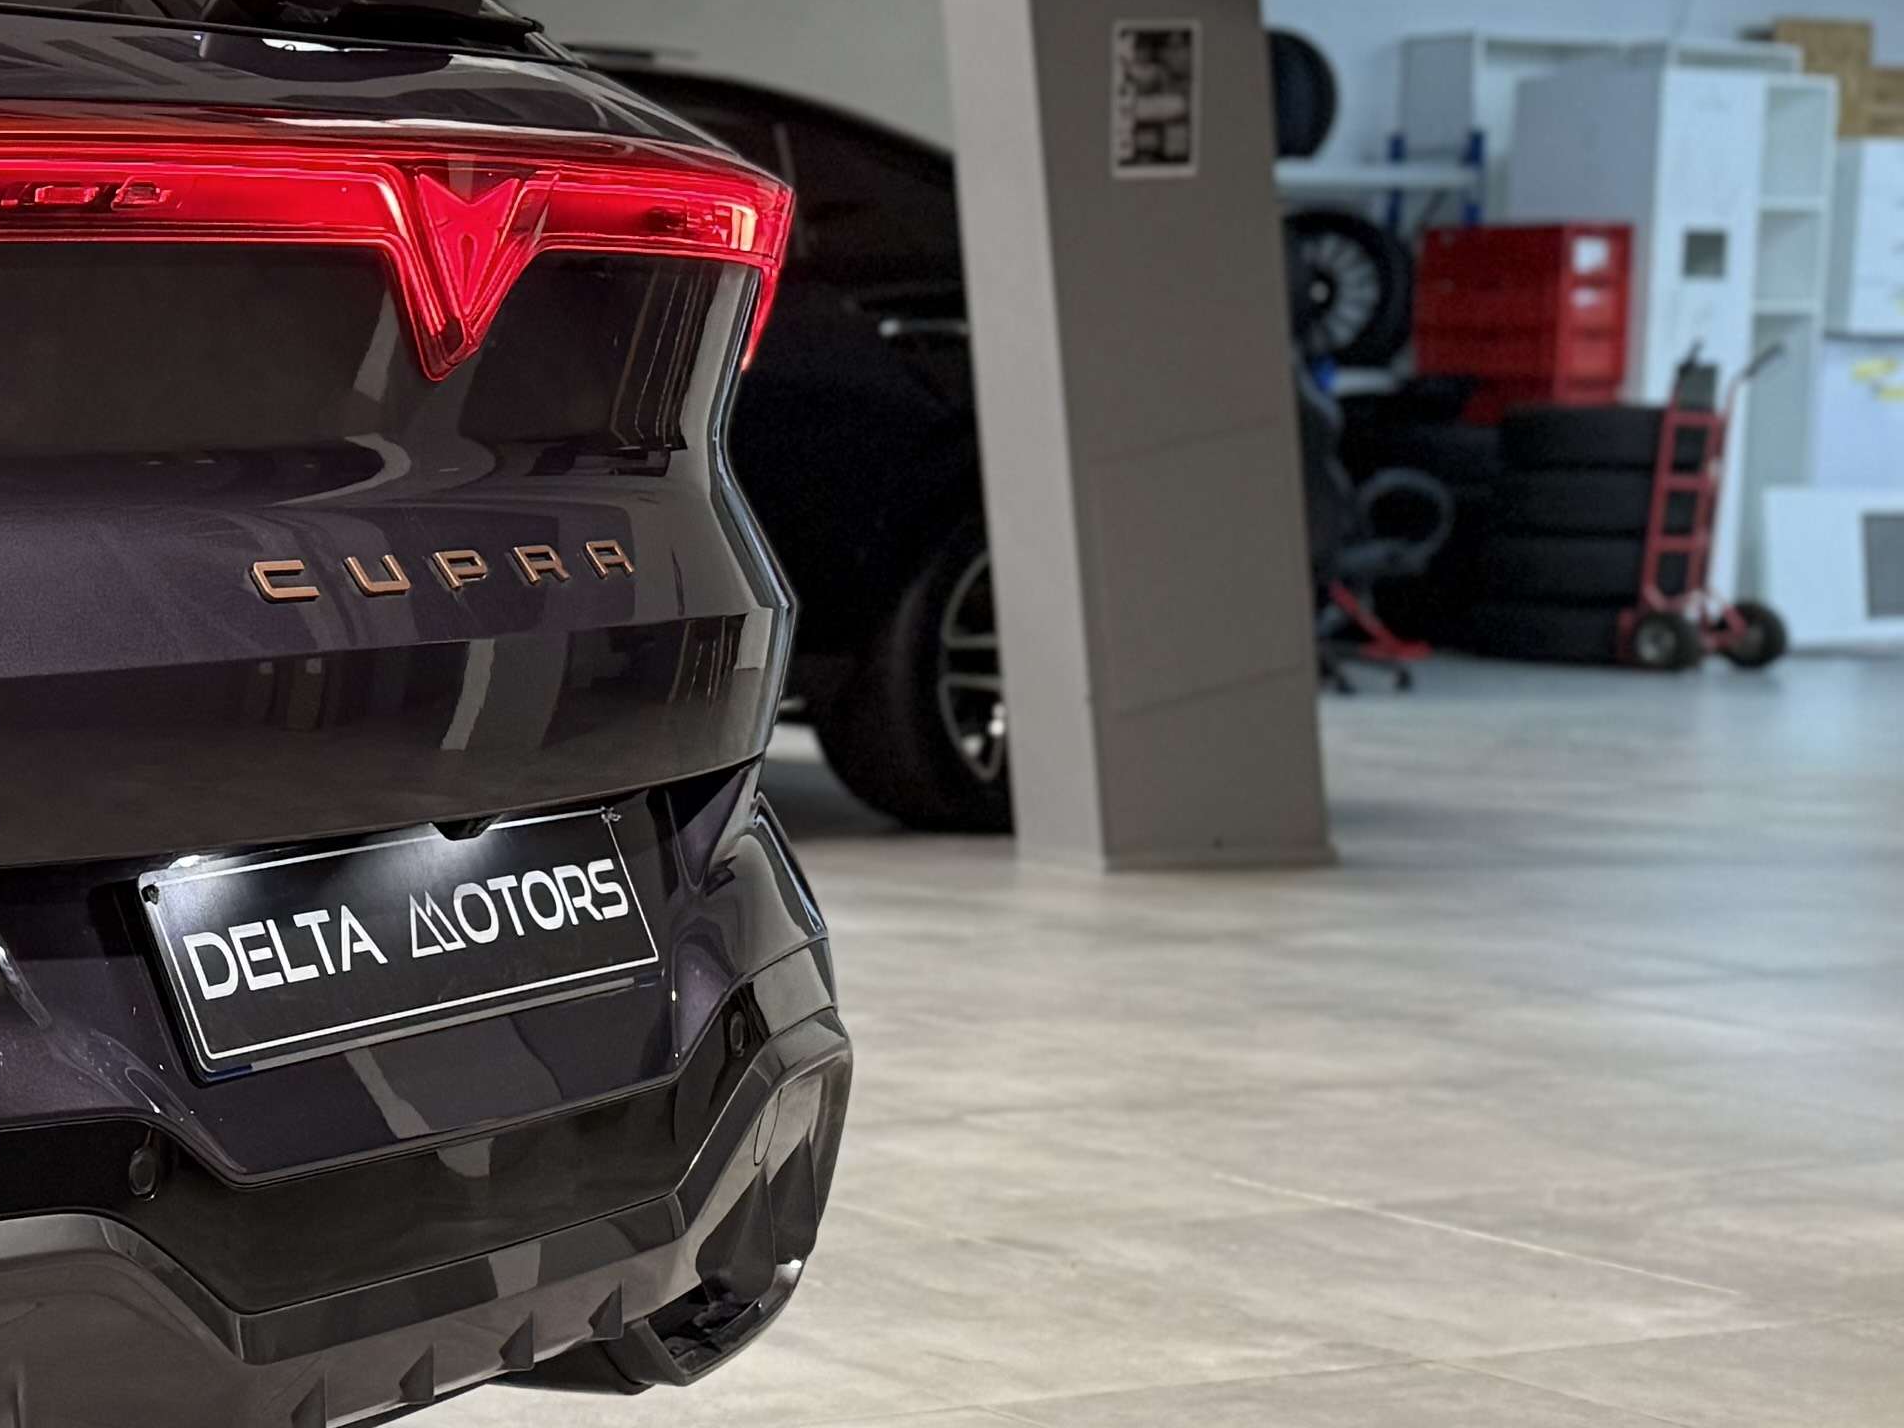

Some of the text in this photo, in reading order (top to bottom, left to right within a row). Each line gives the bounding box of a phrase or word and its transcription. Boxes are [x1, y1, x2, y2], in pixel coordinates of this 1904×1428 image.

[251, 538, 635, 602] CUPRA
[182, 857, 630, 1001] DELTA MOTORS
